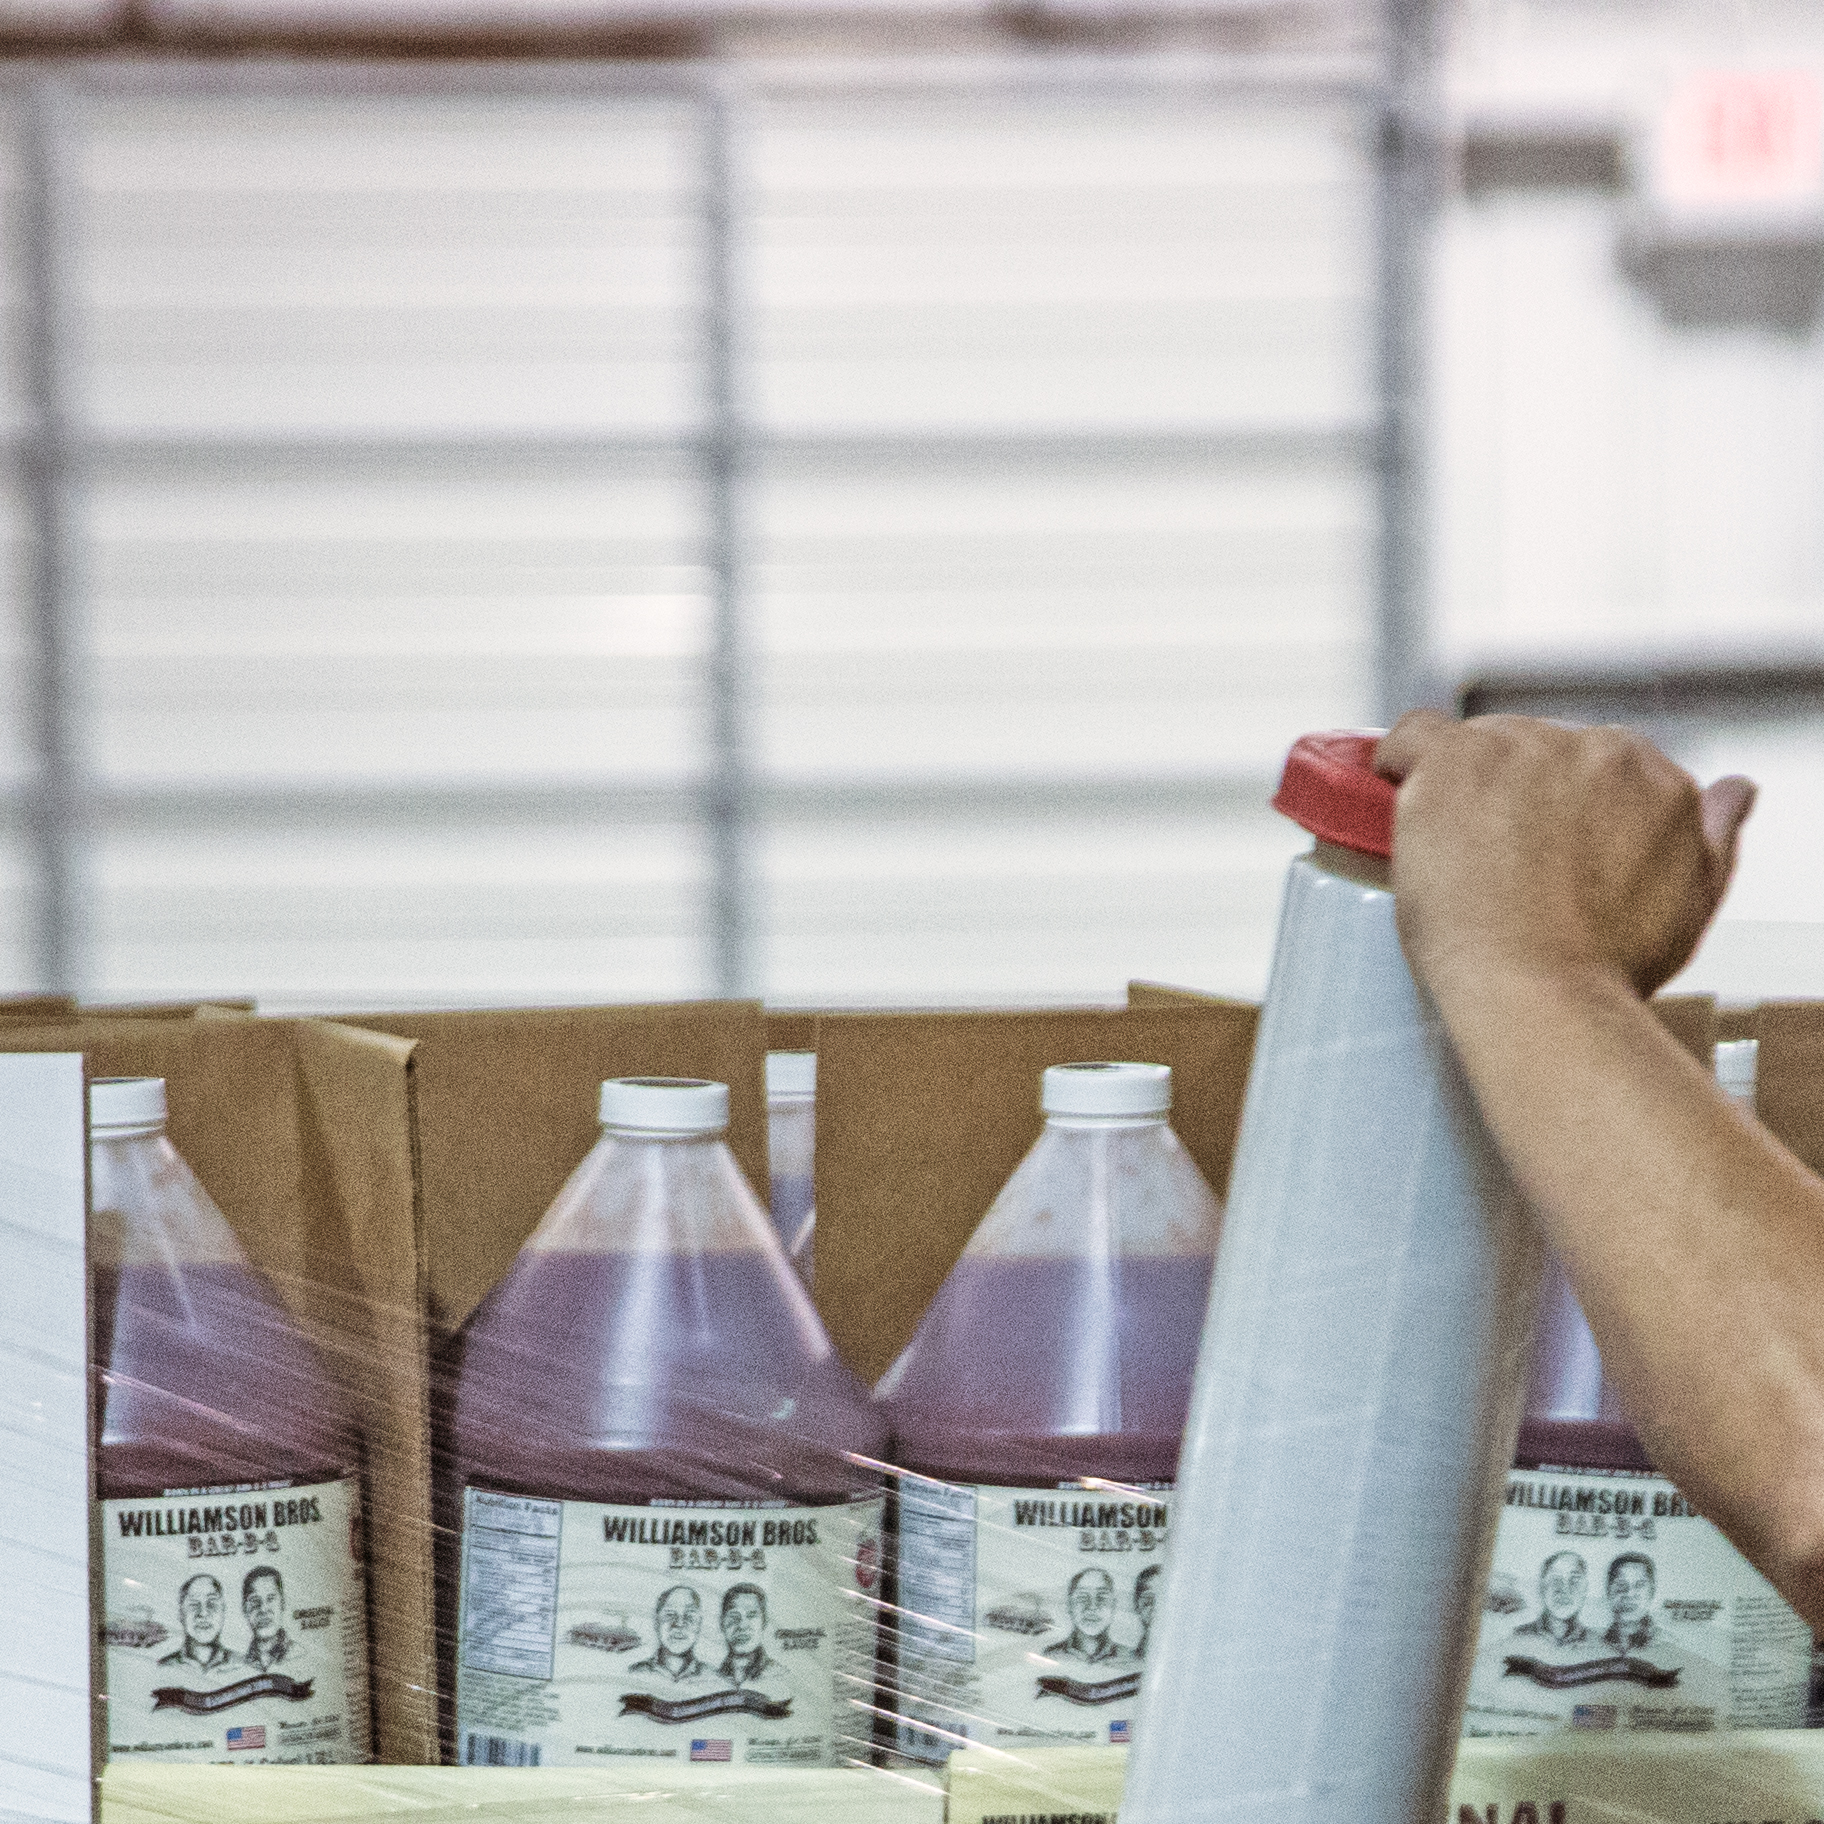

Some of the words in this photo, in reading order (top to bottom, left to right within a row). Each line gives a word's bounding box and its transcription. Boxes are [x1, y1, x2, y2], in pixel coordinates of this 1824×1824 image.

[119, 1503, 267, 1537] WILLIAMSON
[273, 1497, 323, 1527] BROS.
[1014, 1499, 1167, 1528] WILLIAMSON
[603, 1515, 756, 1546] WILLIAMSON
[763, 1518, 822, 1546] BROS.
[1080, 1530, 1165, 1553] BAR-B-
